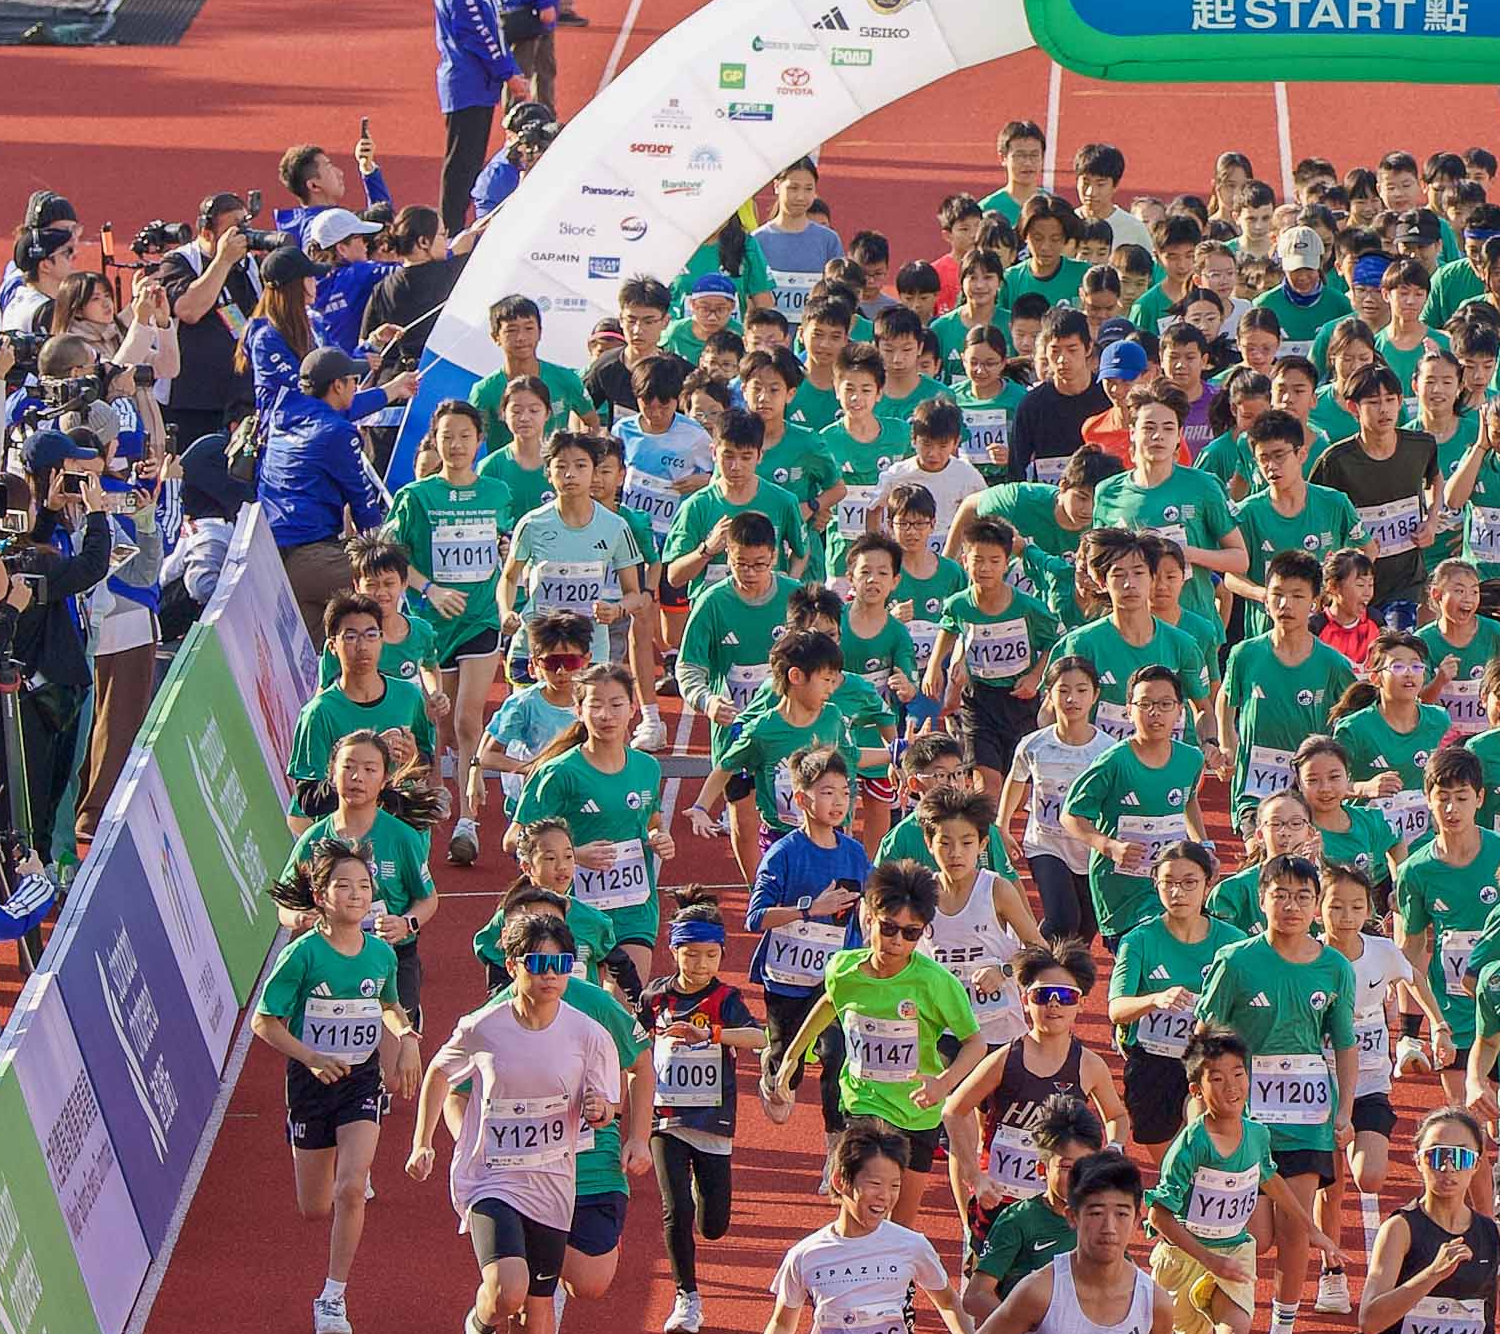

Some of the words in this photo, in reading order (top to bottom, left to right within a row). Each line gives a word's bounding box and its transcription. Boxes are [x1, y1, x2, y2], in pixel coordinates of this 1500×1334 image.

[859, 26, 910, 39] SEIKO
[776, 87, 814, 96] TOYOTA
[630, 143, 674, 154] SOYJOY
[581, 185, 635, 197] Panasonic
[531, 252, 580, 264] GARMIN
[624, 490, 675, 519] Y1070
[436, 545, 494, 567] Y1011
[541, 581, 600, 602] Y1202
[969, 640, 1028, 664] Y1226
[580, 864, 644, 894] Y1250
[309, 1023, 378, 1047] Y1159
[850, 1038, 915, 1065] Y1147
[1257, 1079, 1328, 1105] Y1203
[491, 1119, 565, 1151] Y1219
[1197, 1189, 1258, 1220] Y1315
[815, 1263, 899, 1281] SPAZIO
